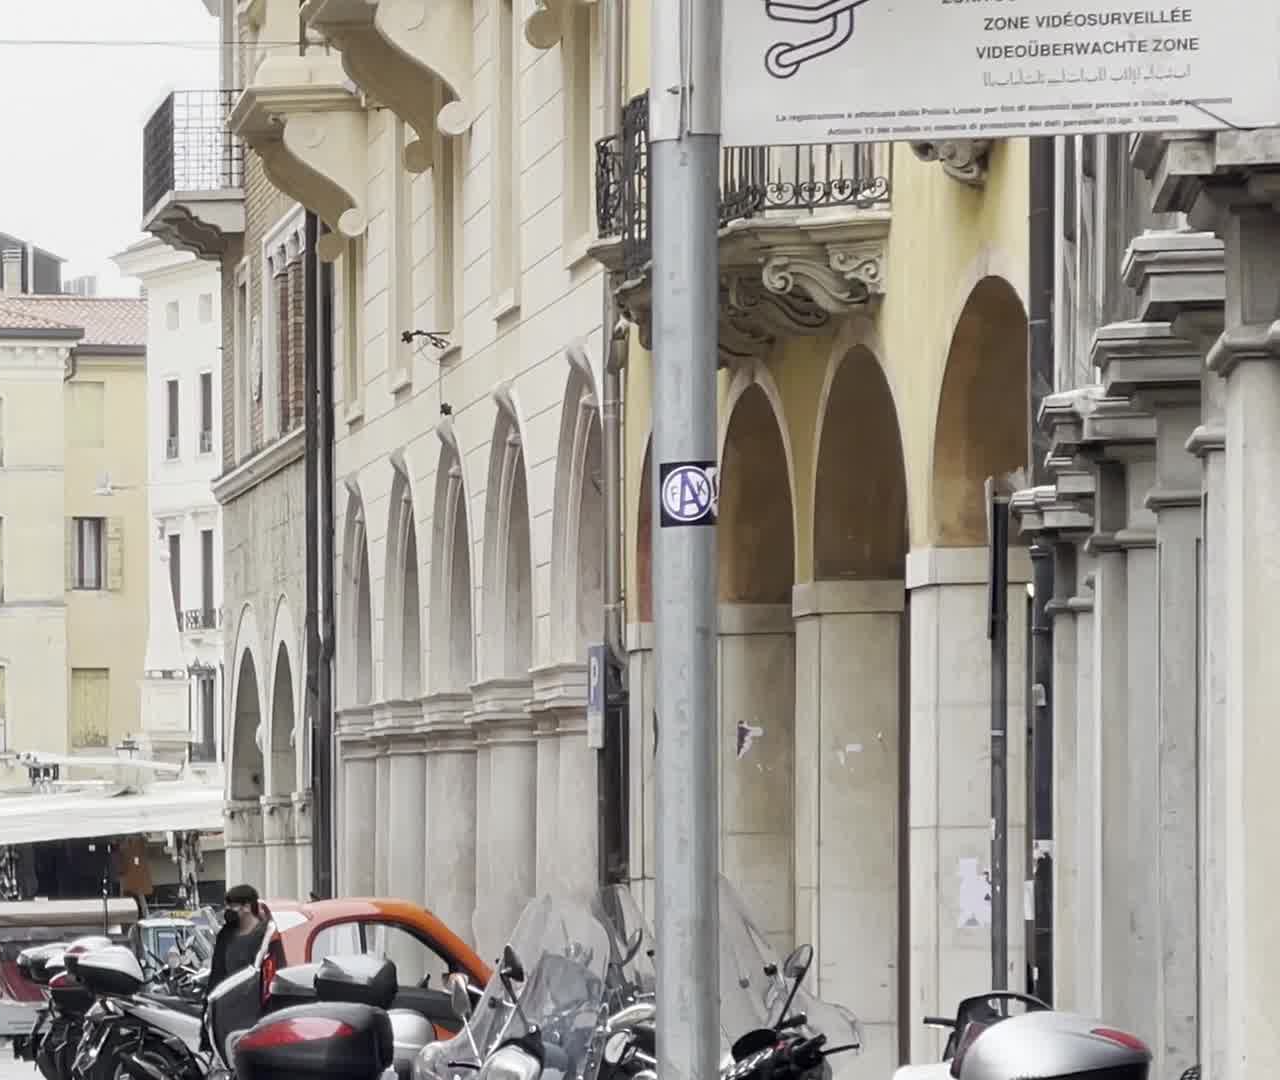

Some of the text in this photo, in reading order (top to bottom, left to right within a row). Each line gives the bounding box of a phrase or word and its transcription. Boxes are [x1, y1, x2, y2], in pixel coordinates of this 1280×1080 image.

[983, 8, 1193, 31] ZONE VIDÉOSURVEILLÉE
[975, 37, 1200, 60] VIDEOÜBERWACHTE ZONE
